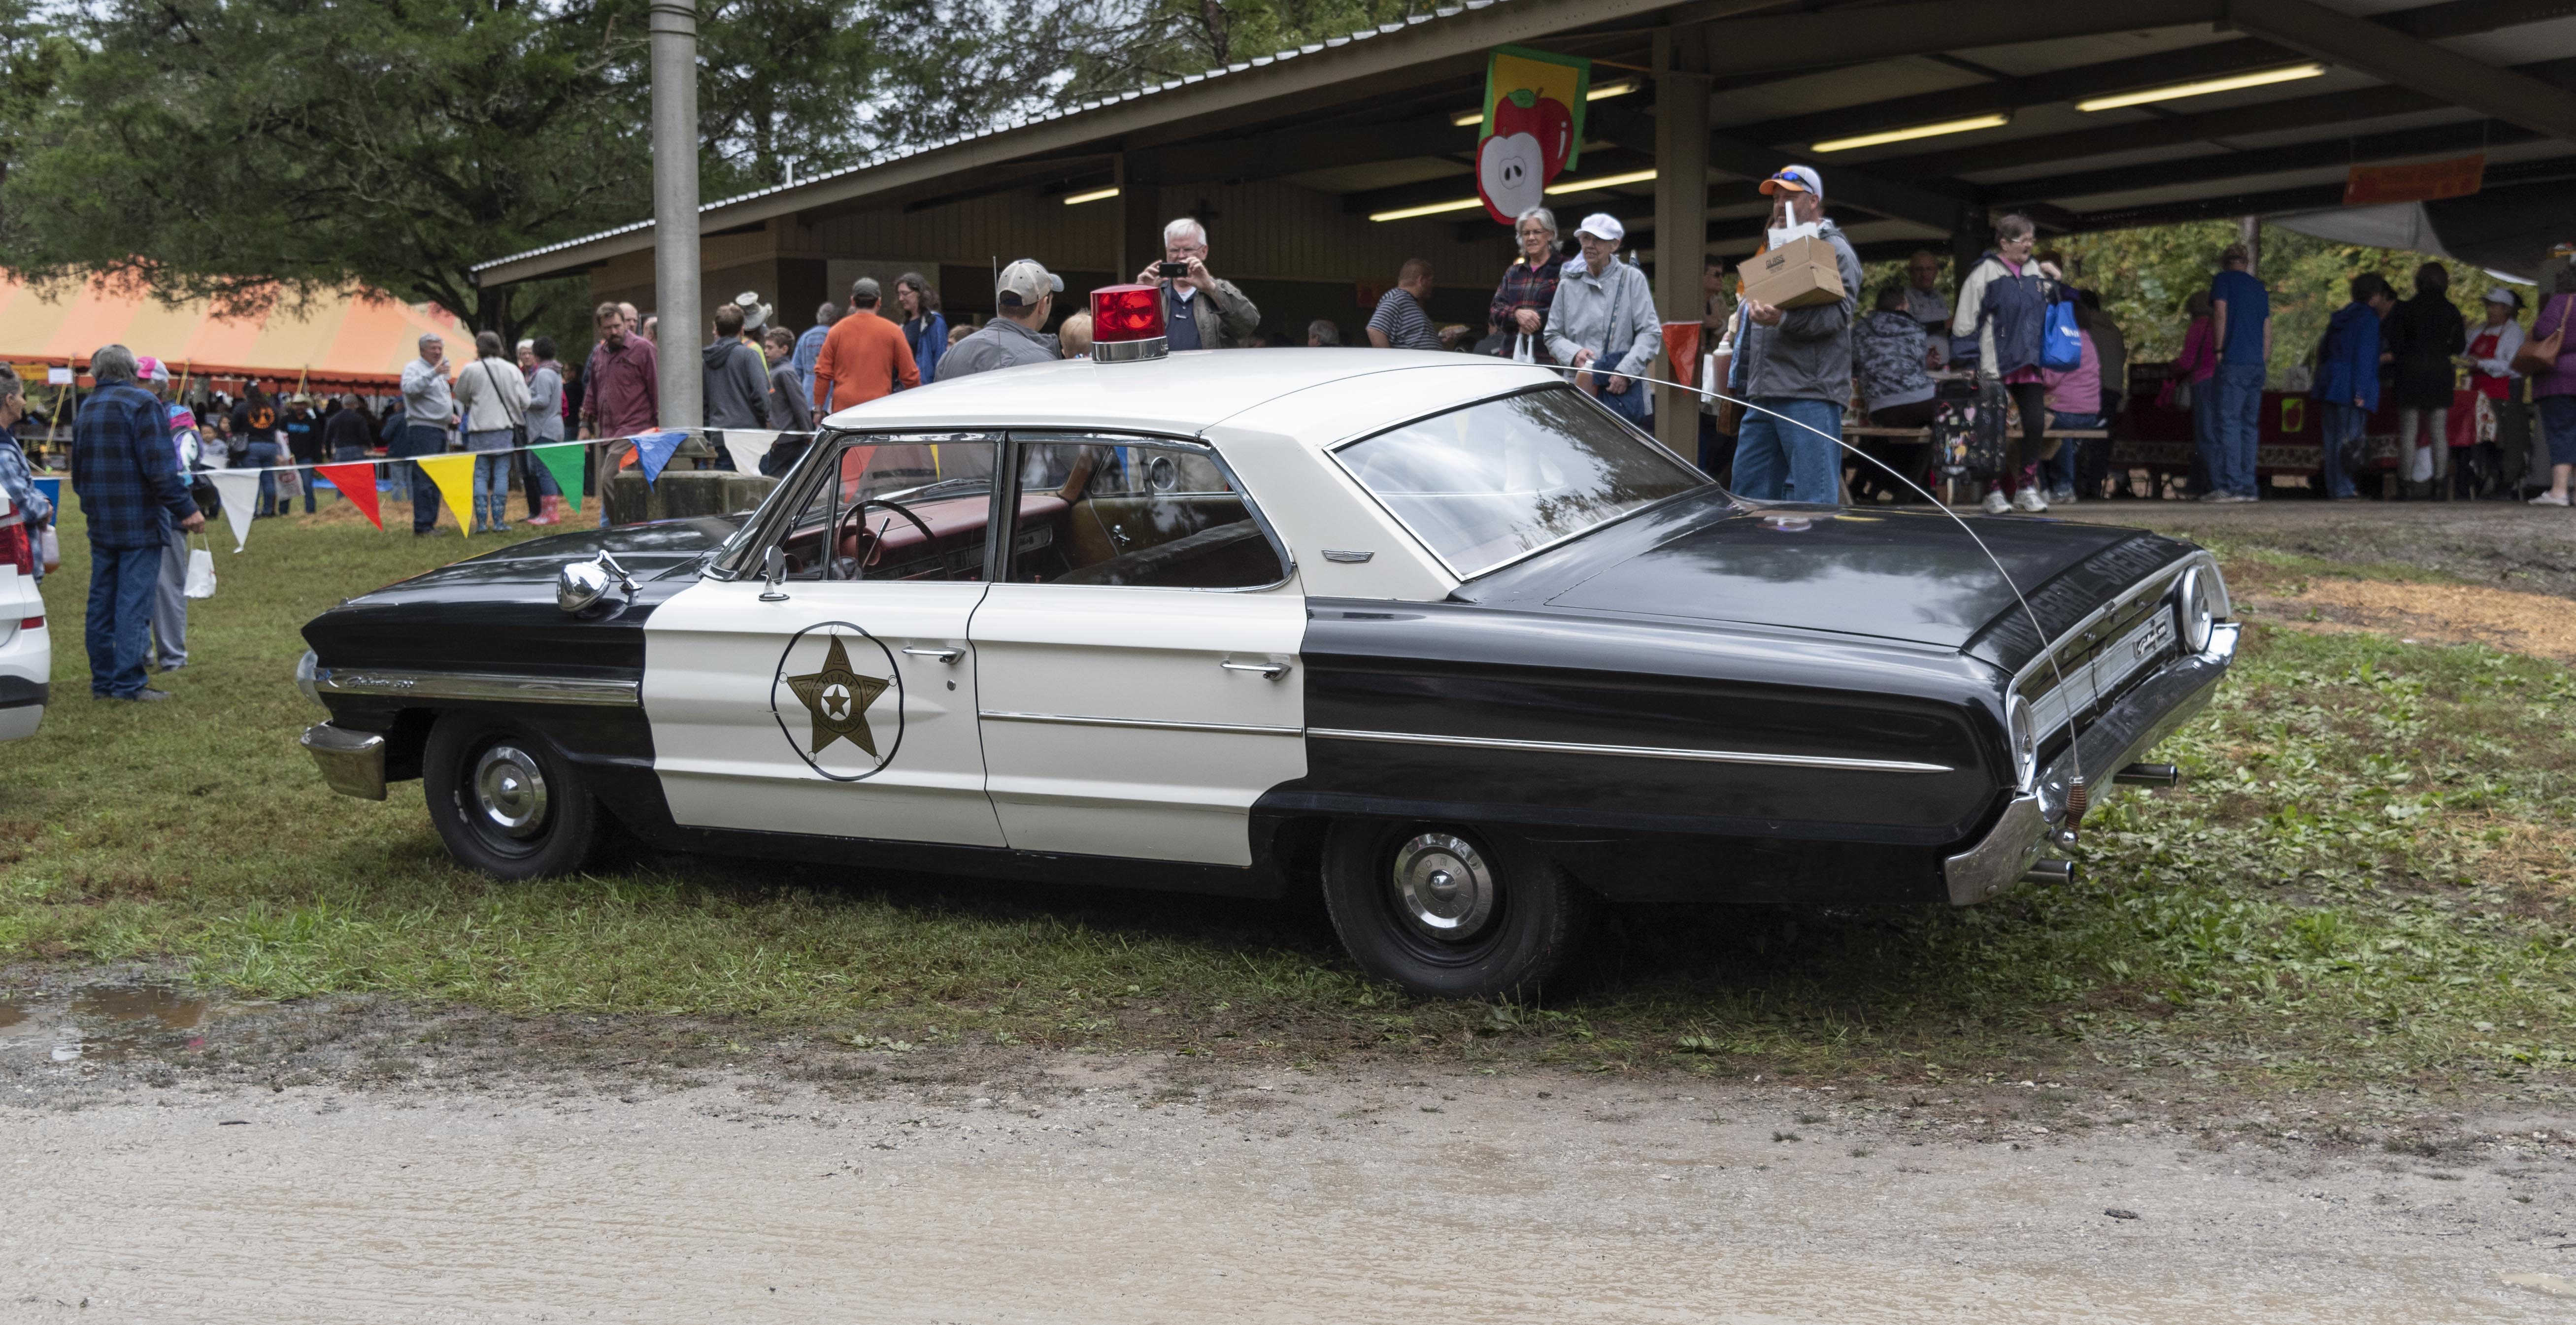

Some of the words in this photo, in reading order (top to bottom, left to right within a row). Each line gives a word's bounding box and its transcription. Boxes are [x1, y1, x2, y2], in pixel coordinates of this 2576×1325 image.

[1766, 254, 1784, 267] GLASS
[2084, 537, 2169, 585] SHERIFF
[816, 673, 859, 694] SHERIFF
